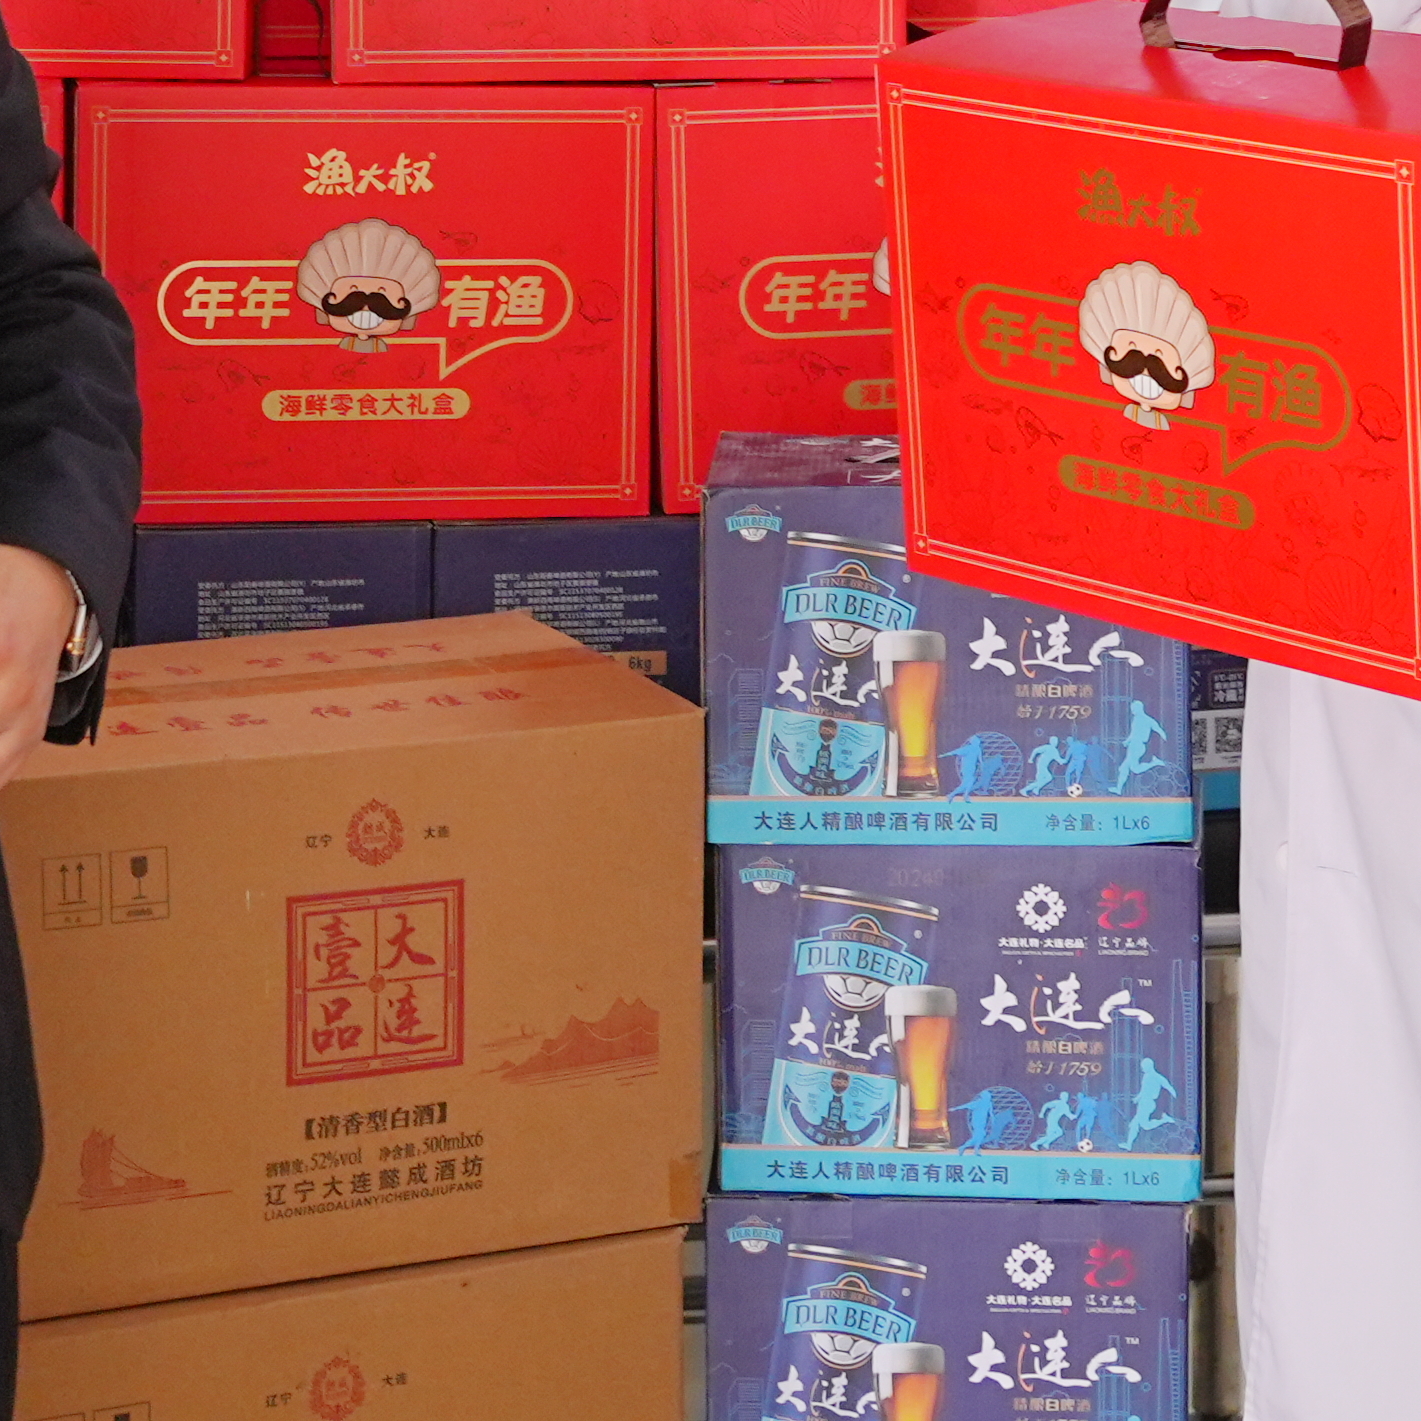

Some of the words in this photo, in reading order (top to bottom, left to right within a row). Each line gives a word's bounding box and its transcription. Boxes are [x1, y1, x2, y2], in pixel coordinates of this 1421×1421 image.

[182, 276, 294, 330] 年年
[441, 274, 546, 328] 有渔
[763, 269, 870, 323] 年年
[979, 302, 1077, 377] 年年
[1219, 350, 1324, 429] 有渔
[278, 391, 456, 418] 海鲜零食大礼盒
[794, 592, 839, 616] DLR
[844, 594, 903, 631] BEER
[305, 834, 332, 849] 辽宁
[424, 825, 450, 840] 大连
[753, 810, 1000, 832] 大连人精酿啤酒有限公司
[806, 946, 850, 969] DLR
[854, 947, 914, 986] BEER
[766, 1159, 1010, 1185] 大连人精酿啤酒有限公司
[794, 1304, 840, 1326] DLR
[843, 1307, 902, 1343] BEER
[265, 1392, 293, 1409] 辽宁
[381, 1372, 408, 1386] 大连
